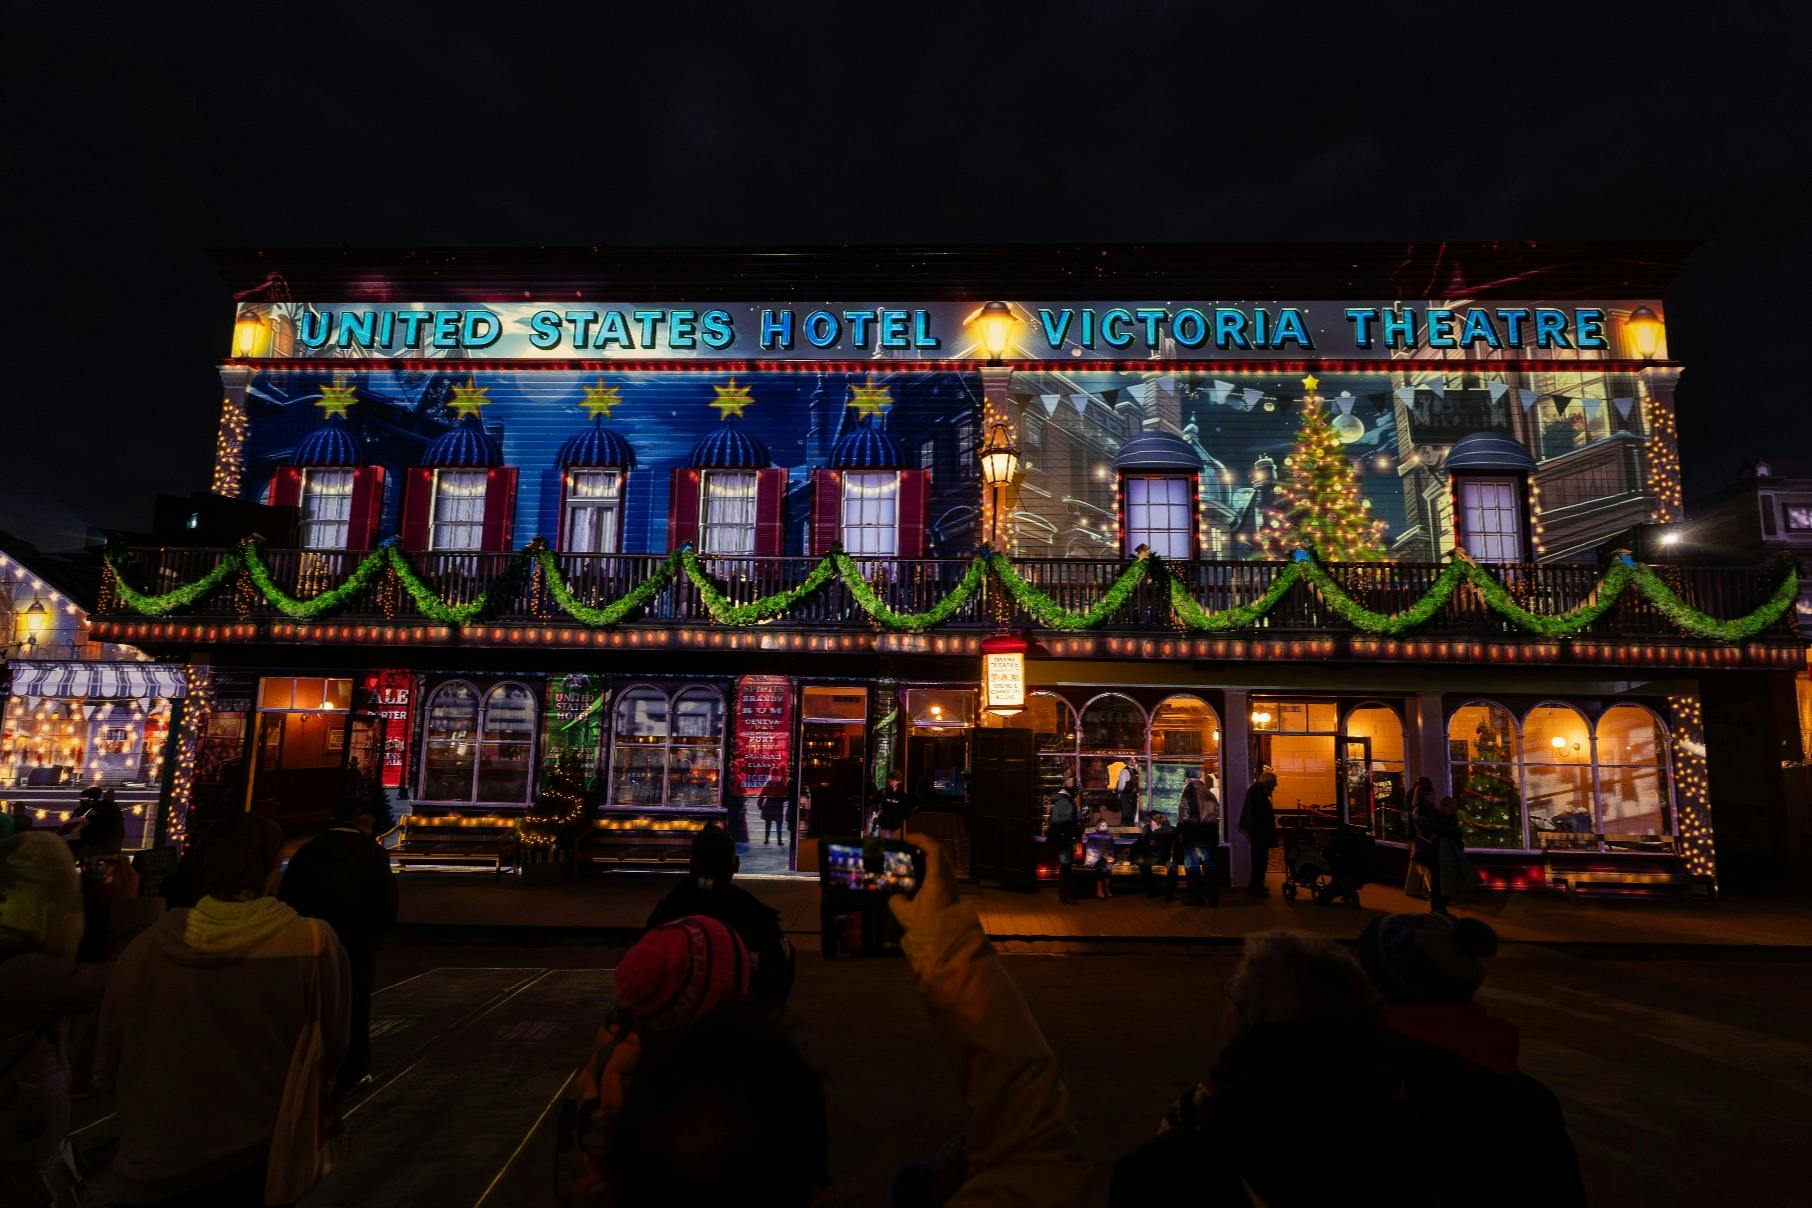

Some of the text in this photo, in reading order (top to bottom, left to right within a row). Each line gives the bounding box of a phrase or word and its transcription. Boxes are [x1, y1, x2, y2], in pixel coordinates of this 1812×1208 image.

[300, 309, 941, 350] UNITED STATES HOTEL
[1038, 307, 1609, 350] VICTORIA THEATRE
[367, 688, 409, 705] ALE
[555, 693, 594, 702] UNITED
[556, 702, 593, 711] STATES
